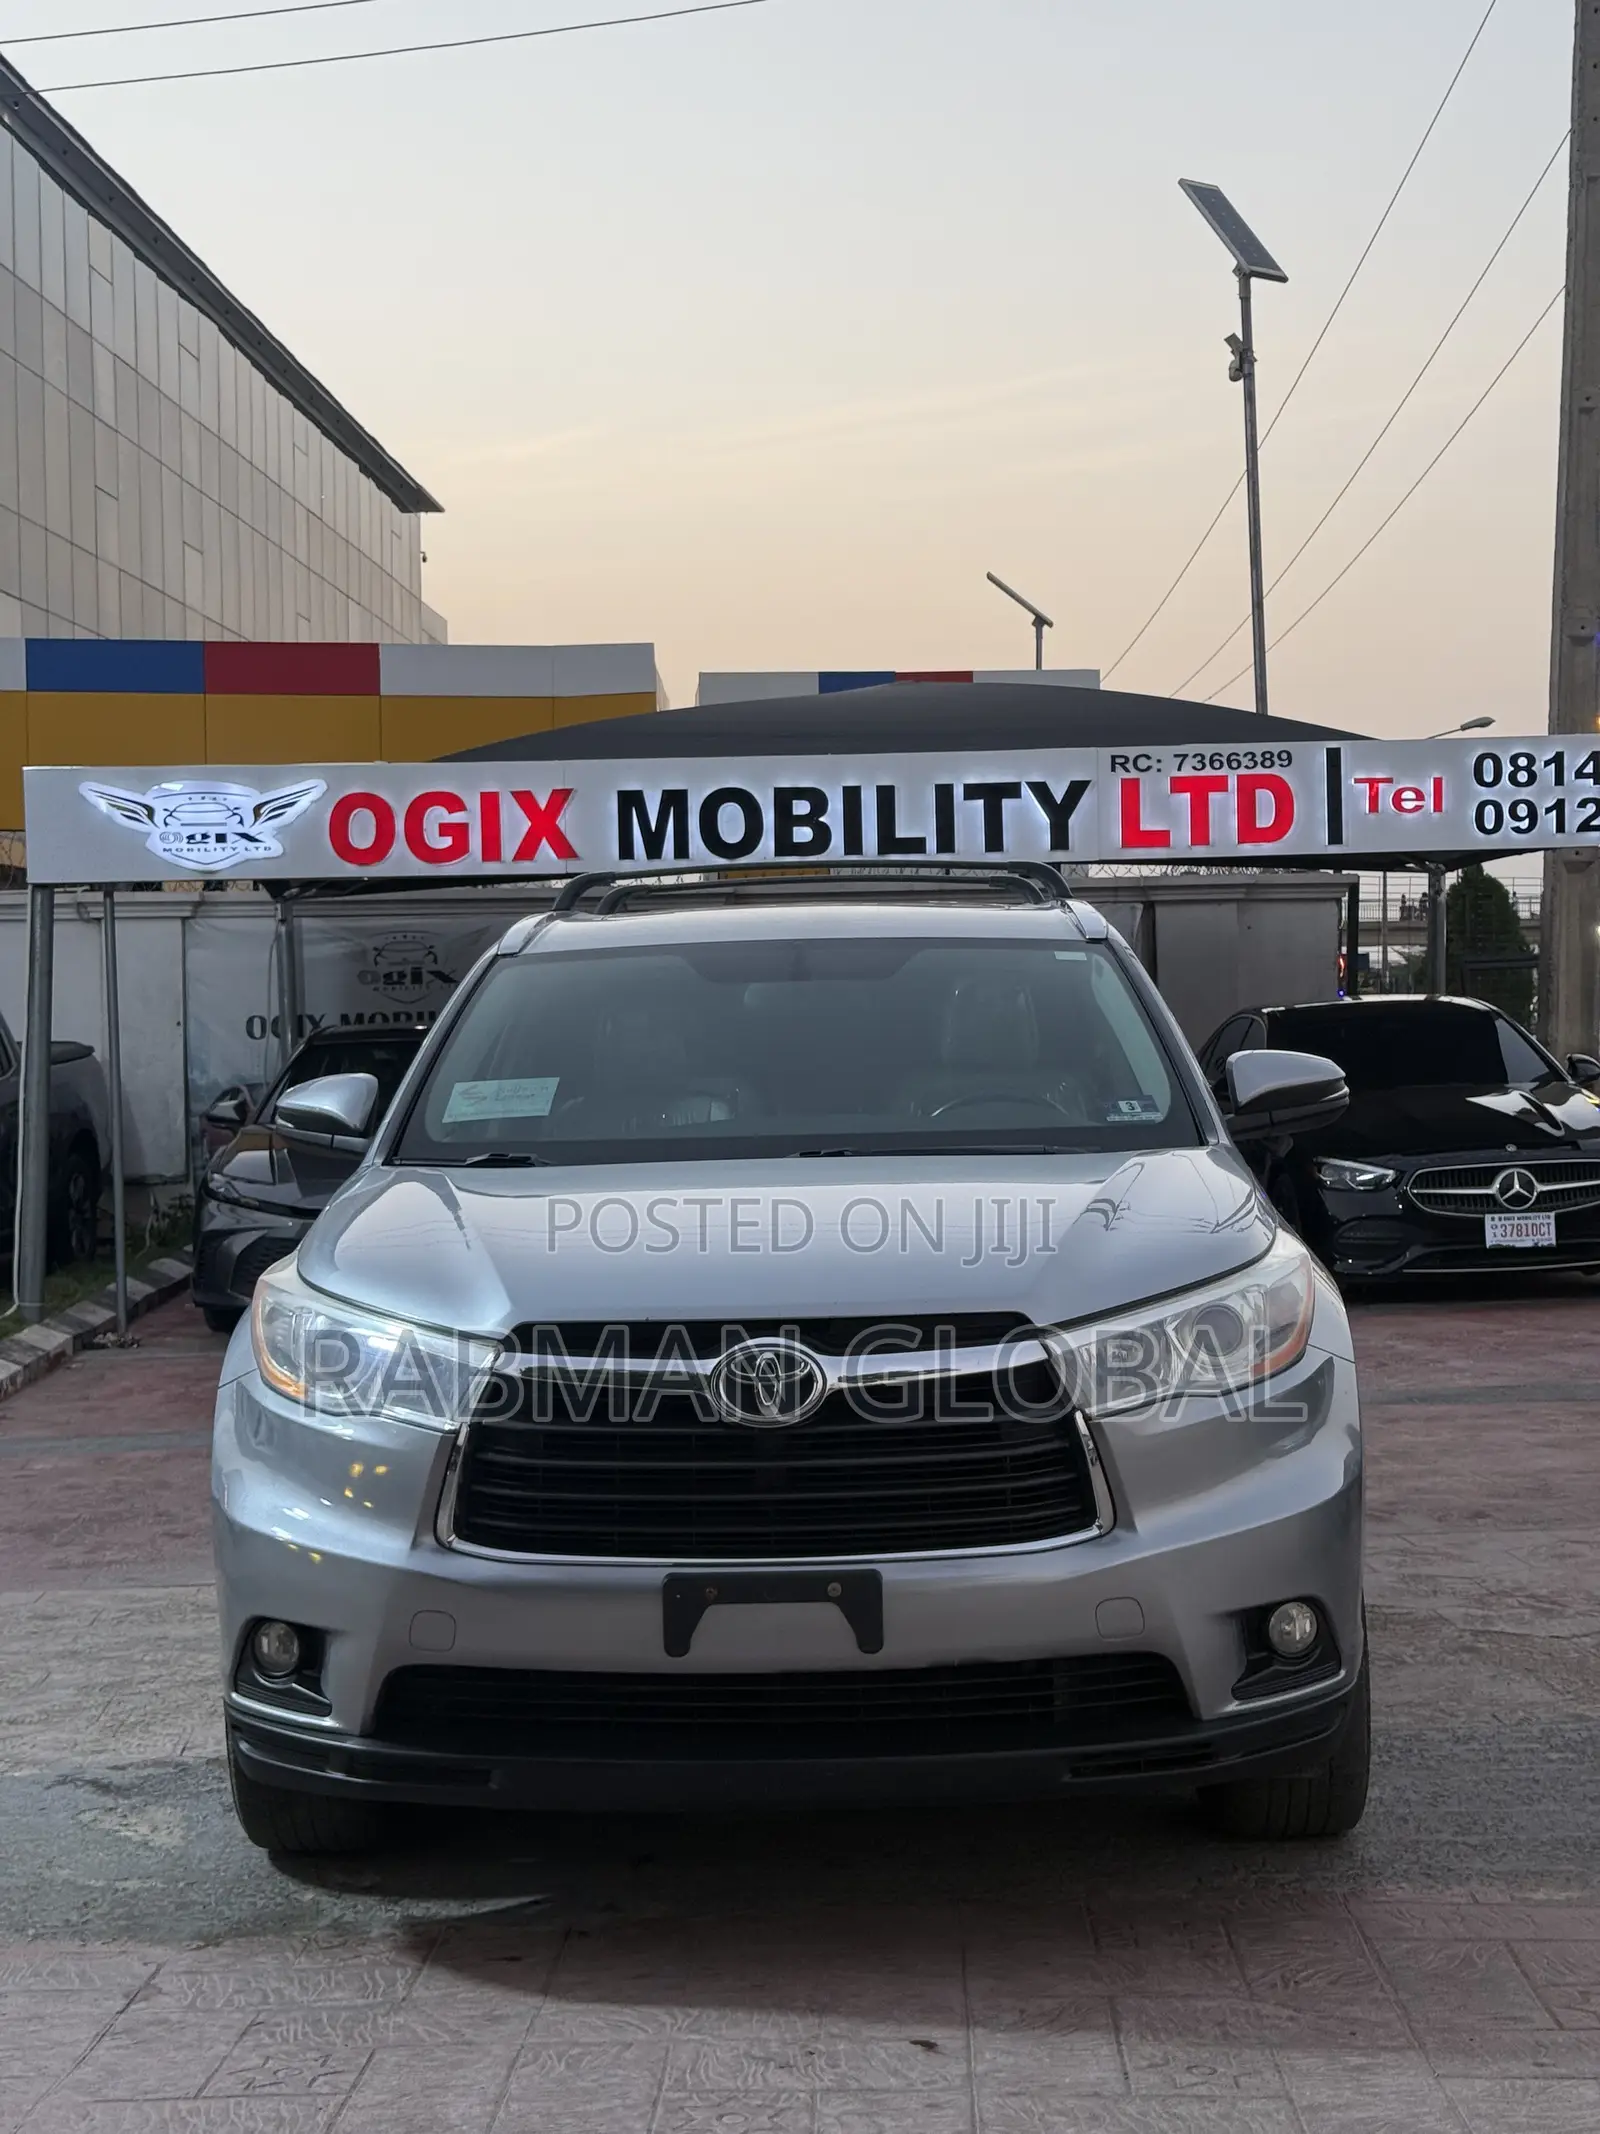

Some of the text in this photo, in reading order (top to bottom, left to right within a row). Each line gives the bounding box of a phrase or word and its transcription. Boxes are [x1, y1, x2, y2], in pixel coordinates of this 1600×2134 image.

[1110, 750, 1293, 773] RC: 7366389
[1473, 751, 1600, 788] 0814
[1353, 777, 1443, 814] Tel
[329, 773, 1295, 867] OGIX MOBILITY LTD
[1474, 797, 1600, 835] 0912
[1125, 1102, 1135, 1110] 3
